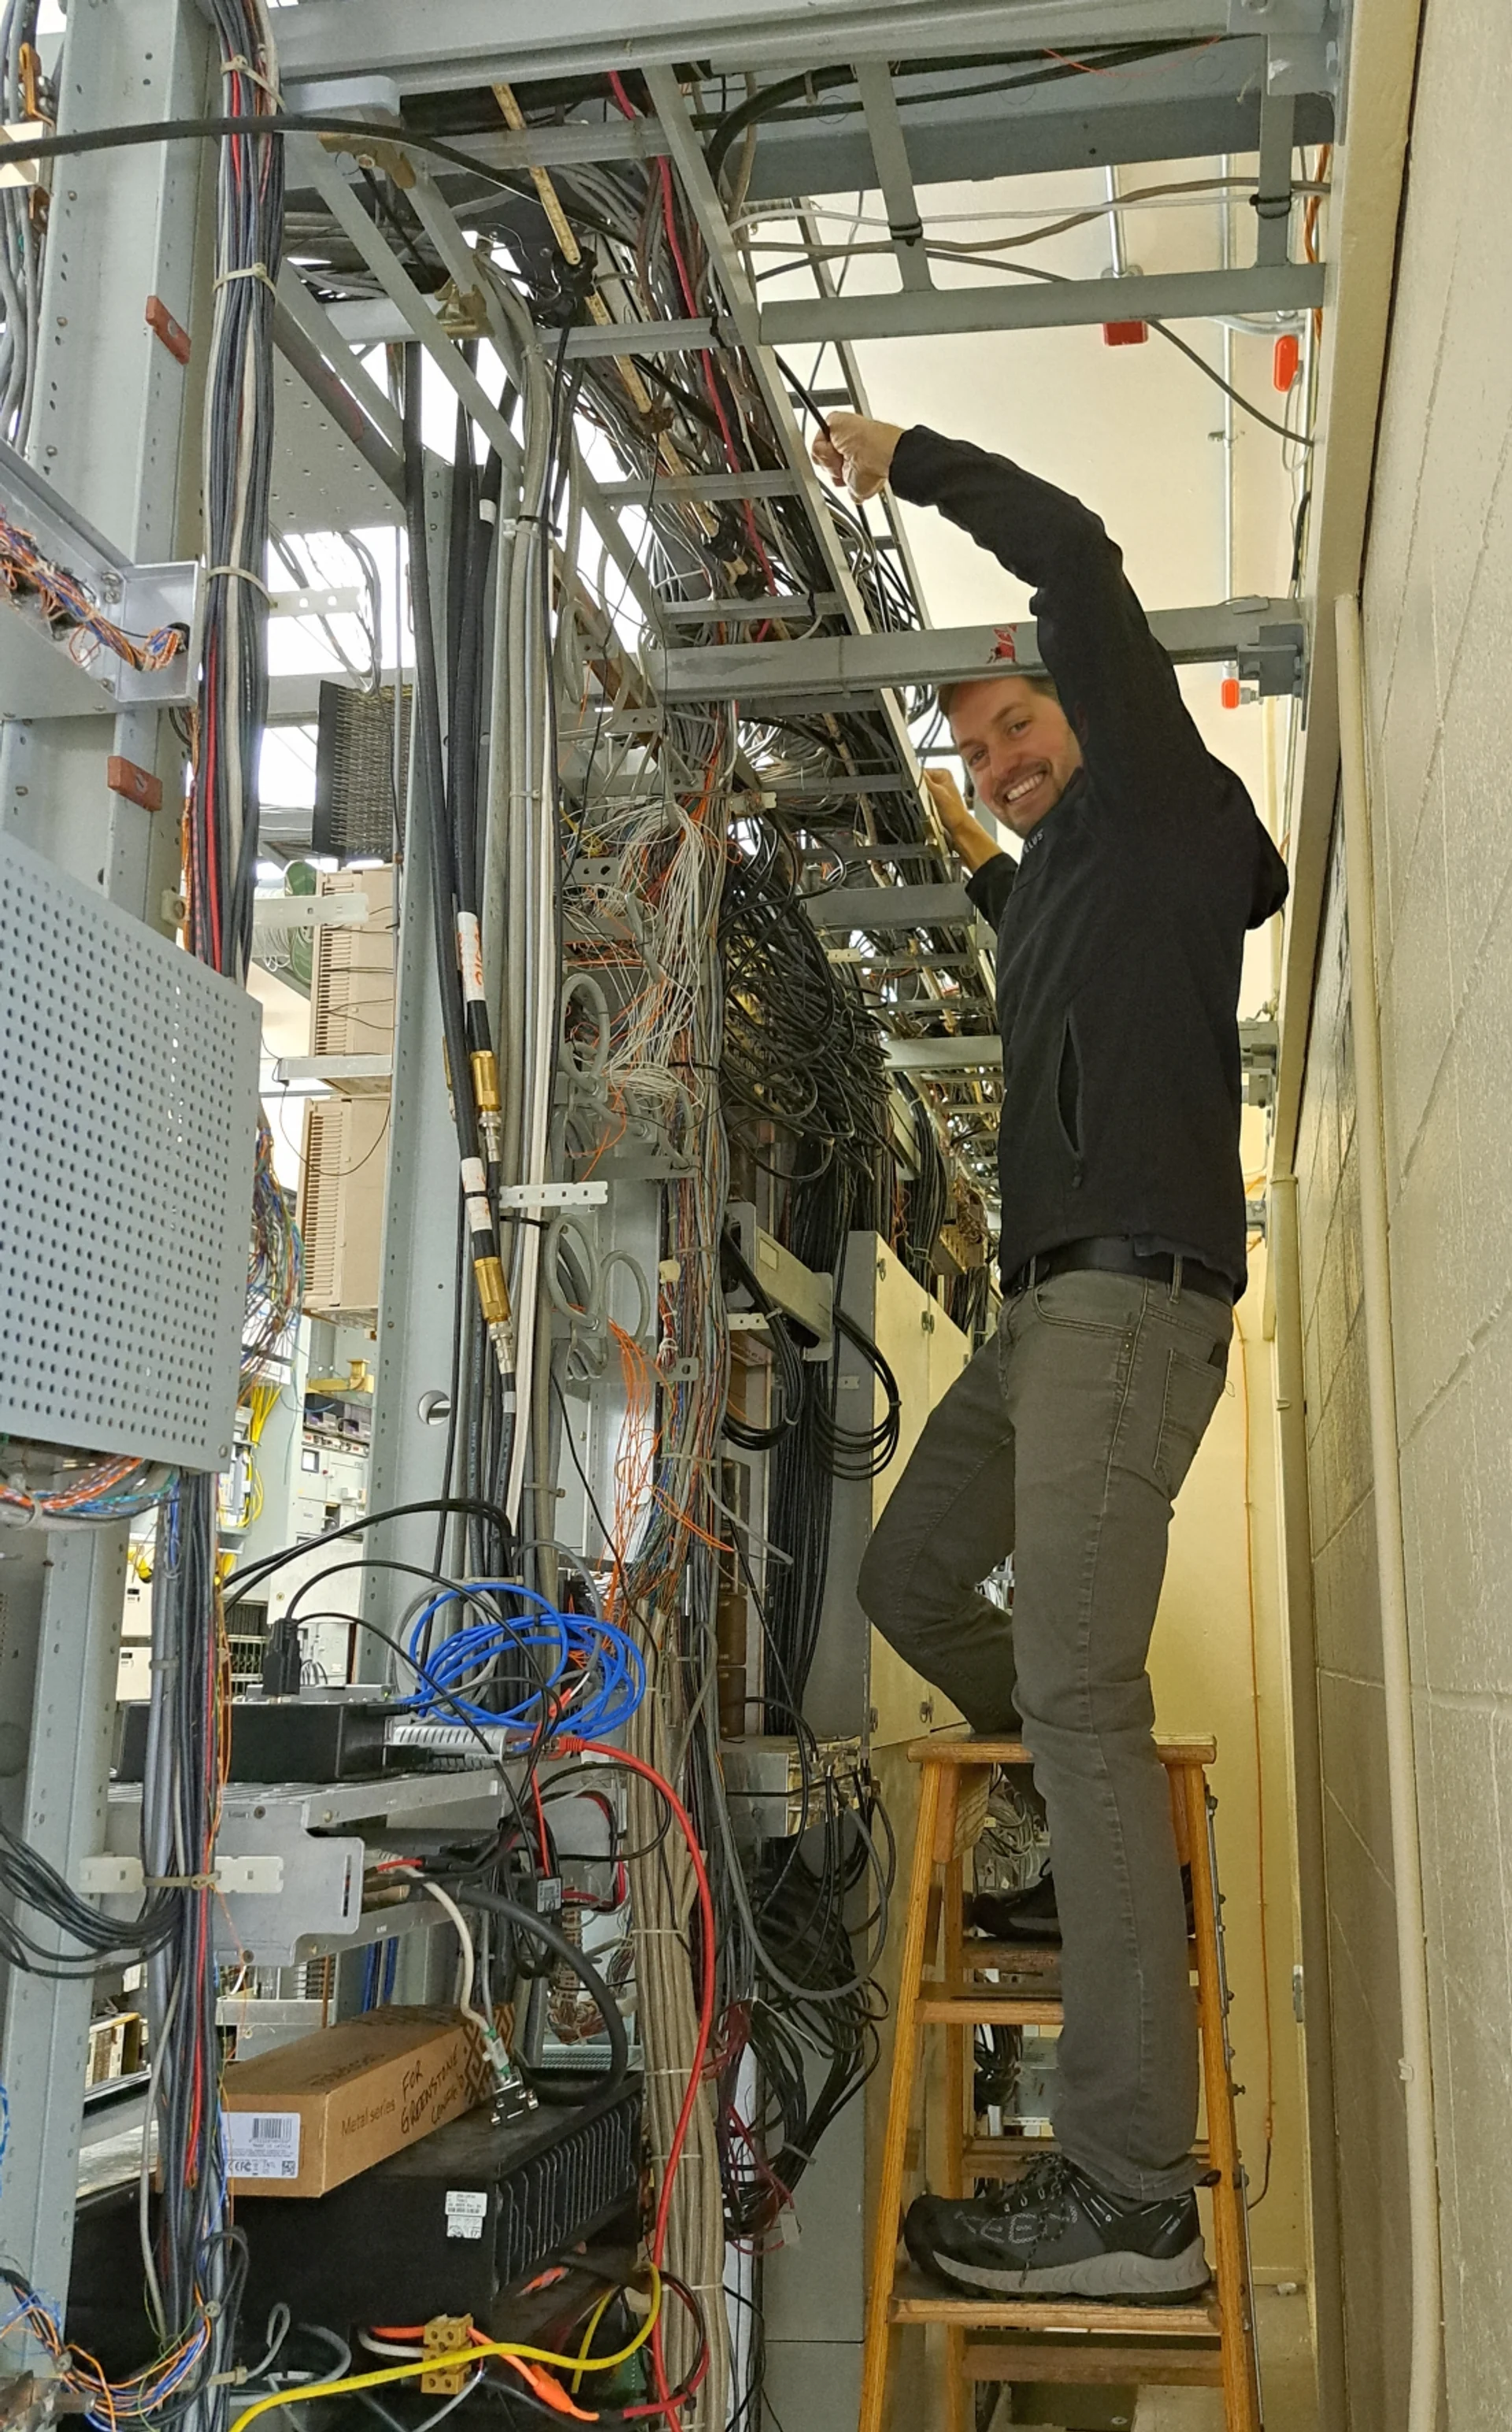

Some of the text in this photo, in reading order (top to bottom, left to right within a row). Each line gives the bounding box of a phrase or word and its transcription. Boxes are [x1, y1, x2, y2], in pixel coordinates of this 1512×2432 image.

[1022, 829, 1043, 855] ELUS
[400, 2043, 458, 2134] GREENSTONE
[402, 2059, 423, 2101] FOR
[341, 2098, 396, 2137] Metal series
